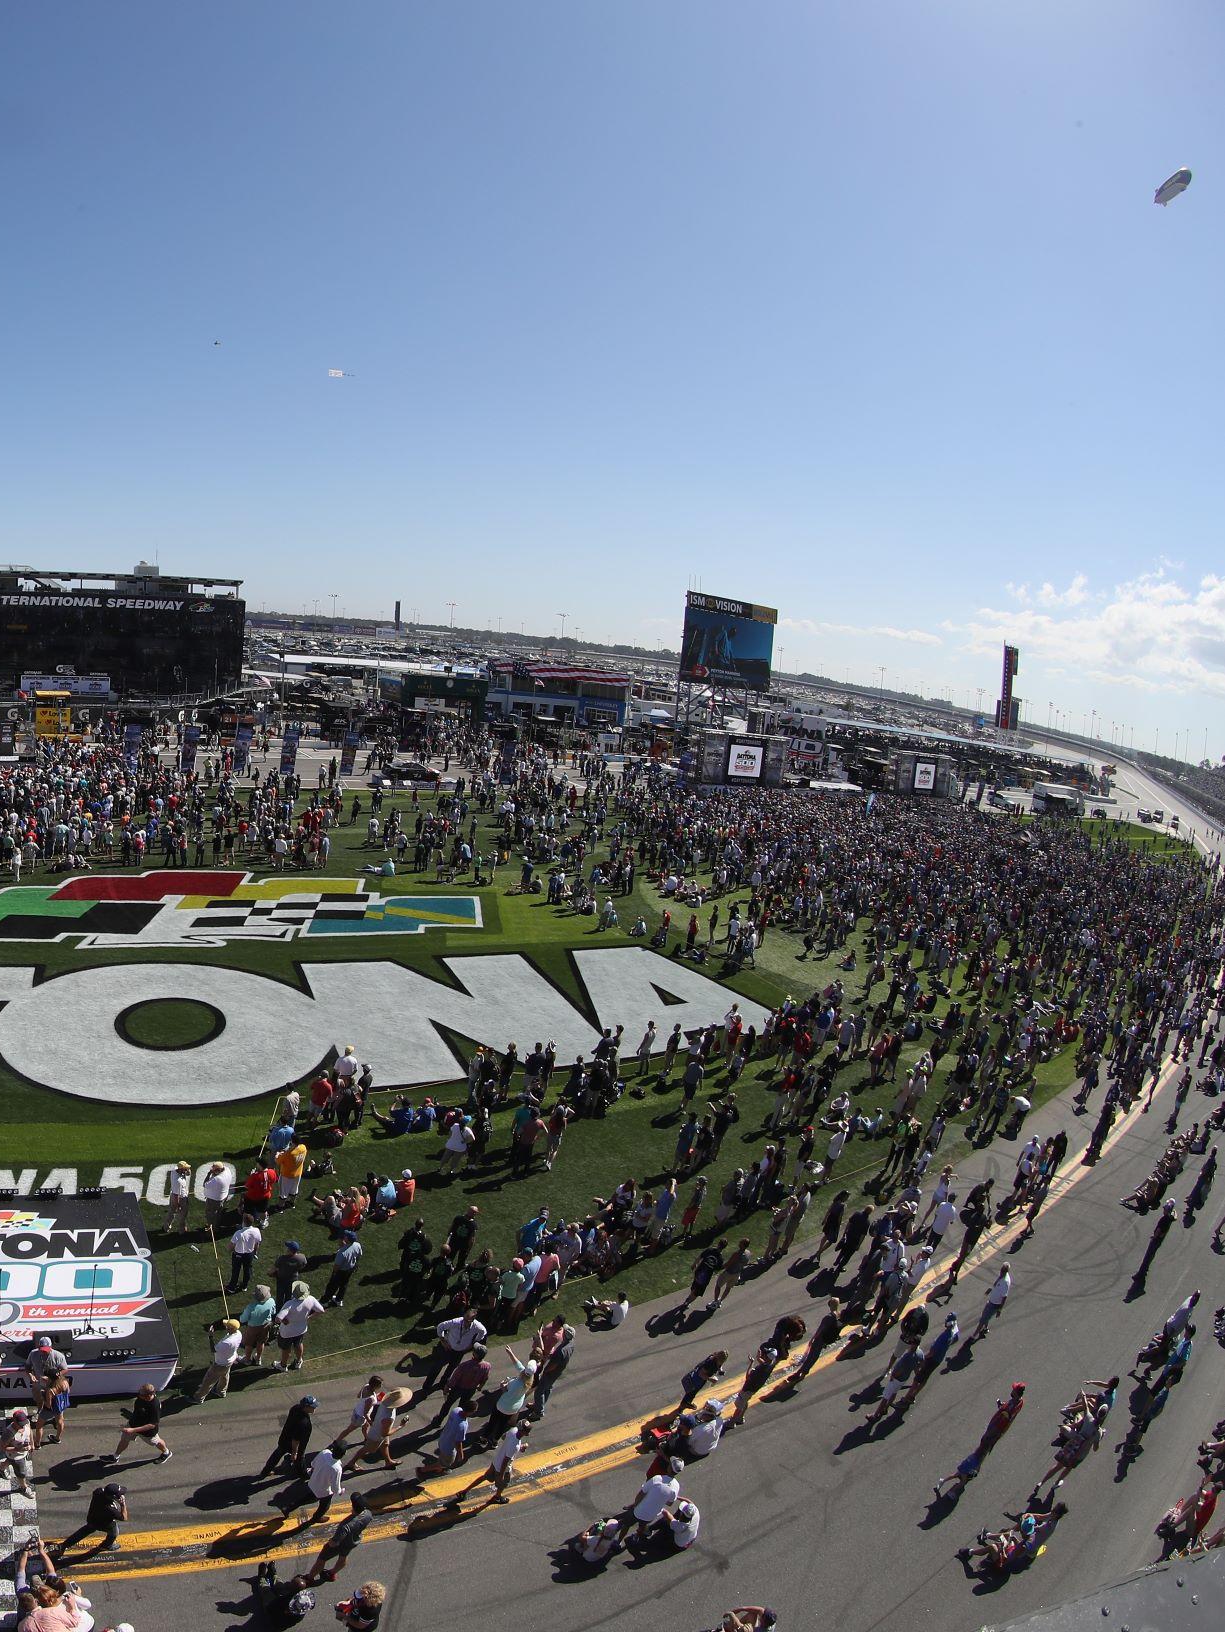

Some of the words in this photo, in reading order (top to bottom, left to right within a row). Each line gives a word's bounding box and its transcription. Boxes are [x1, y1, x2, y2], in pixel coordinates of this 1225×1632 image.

[106, 598, 184, 611] SPEEDWAY
[690, 594, 706, 607] ISM
[716, 599, 743, 613] VISION
[7, 708, 19, 720] G
[78, 709, 90, 720] G
[53, 1304, 119, 1317] annual
